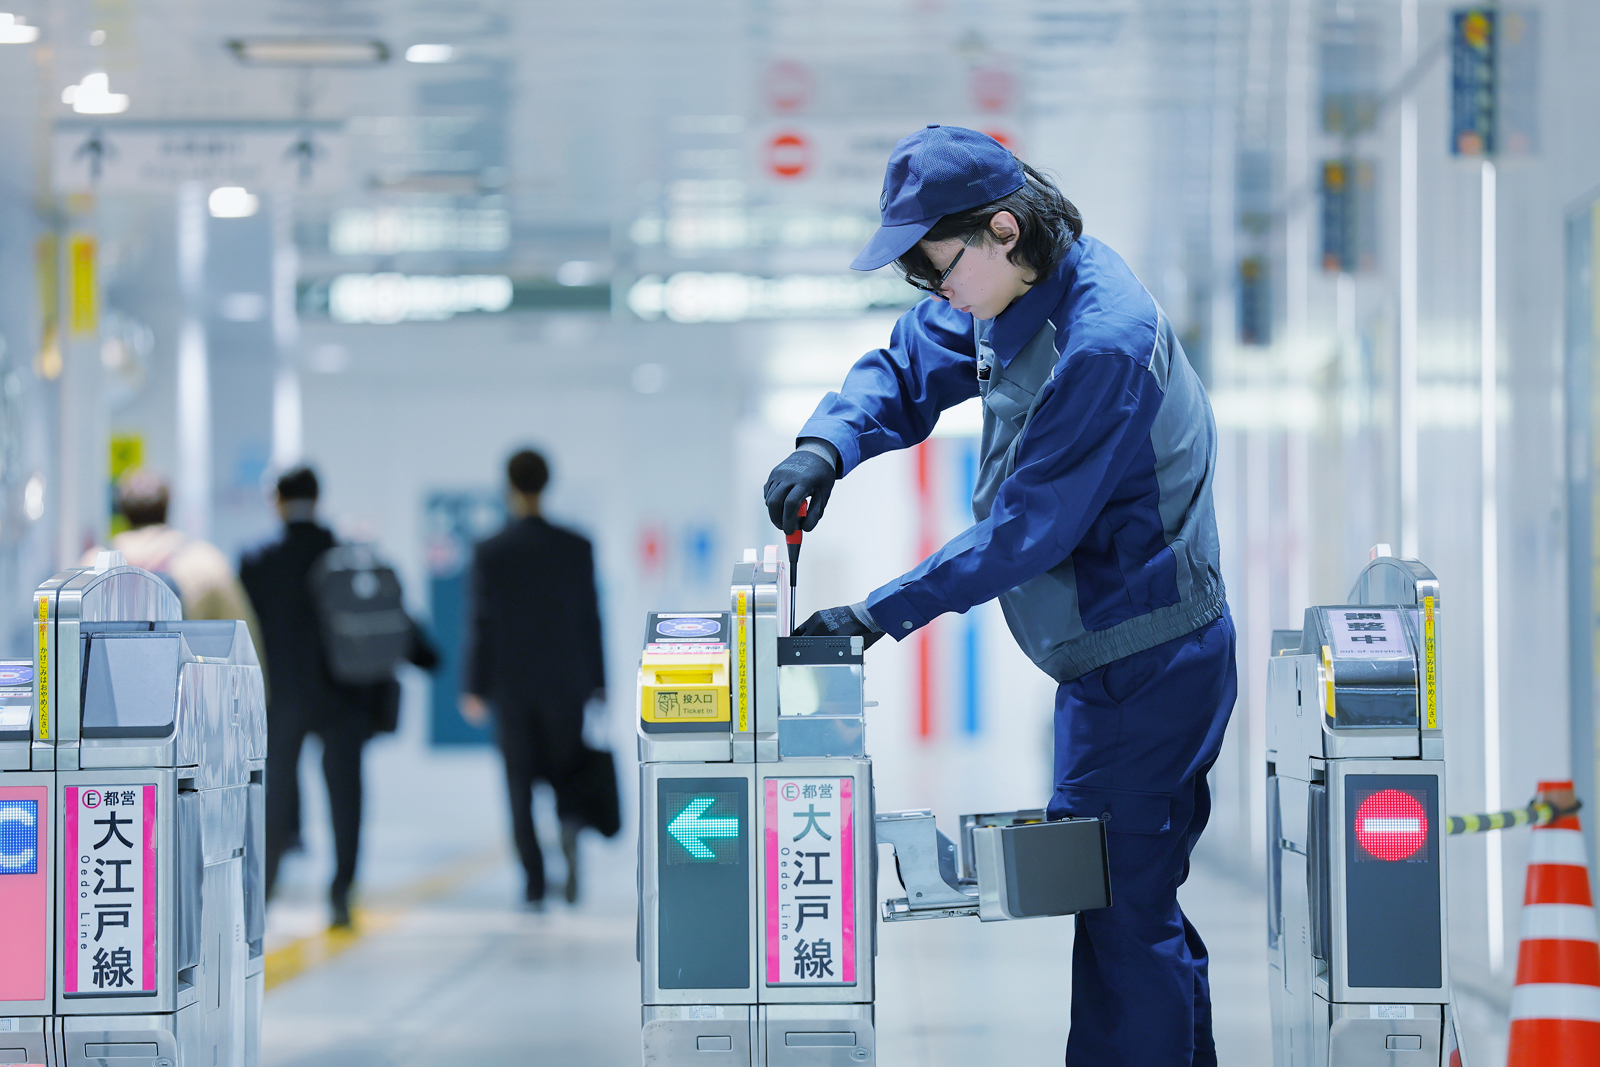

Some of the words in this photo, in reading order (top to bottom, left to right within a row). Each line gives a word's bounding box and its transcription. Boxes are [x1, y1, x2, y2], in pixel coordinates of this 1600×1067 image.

[1344, 612, 1386, 644] 調整中
[40, 647, 48, 735] かけこみはおやめください
[683, 694, 712, 704] 投入口
[739, 641, 747, 728] かけこみはおやめください
[1427, 637, 1436, 725] かけこみはおやめください
[103, 790, 136, 806] 都営
[801, 783, 833, 799] 都営
[80, 855, 90, 898] Oedo
[781, 847, 790, 890] Oedo
[92, 811, 135, 988] 大江戸線
[793, 803, 834, 979] 大江戸線
[80, 912, 90, 950] Line
[781, 904, 791, 941] Line
